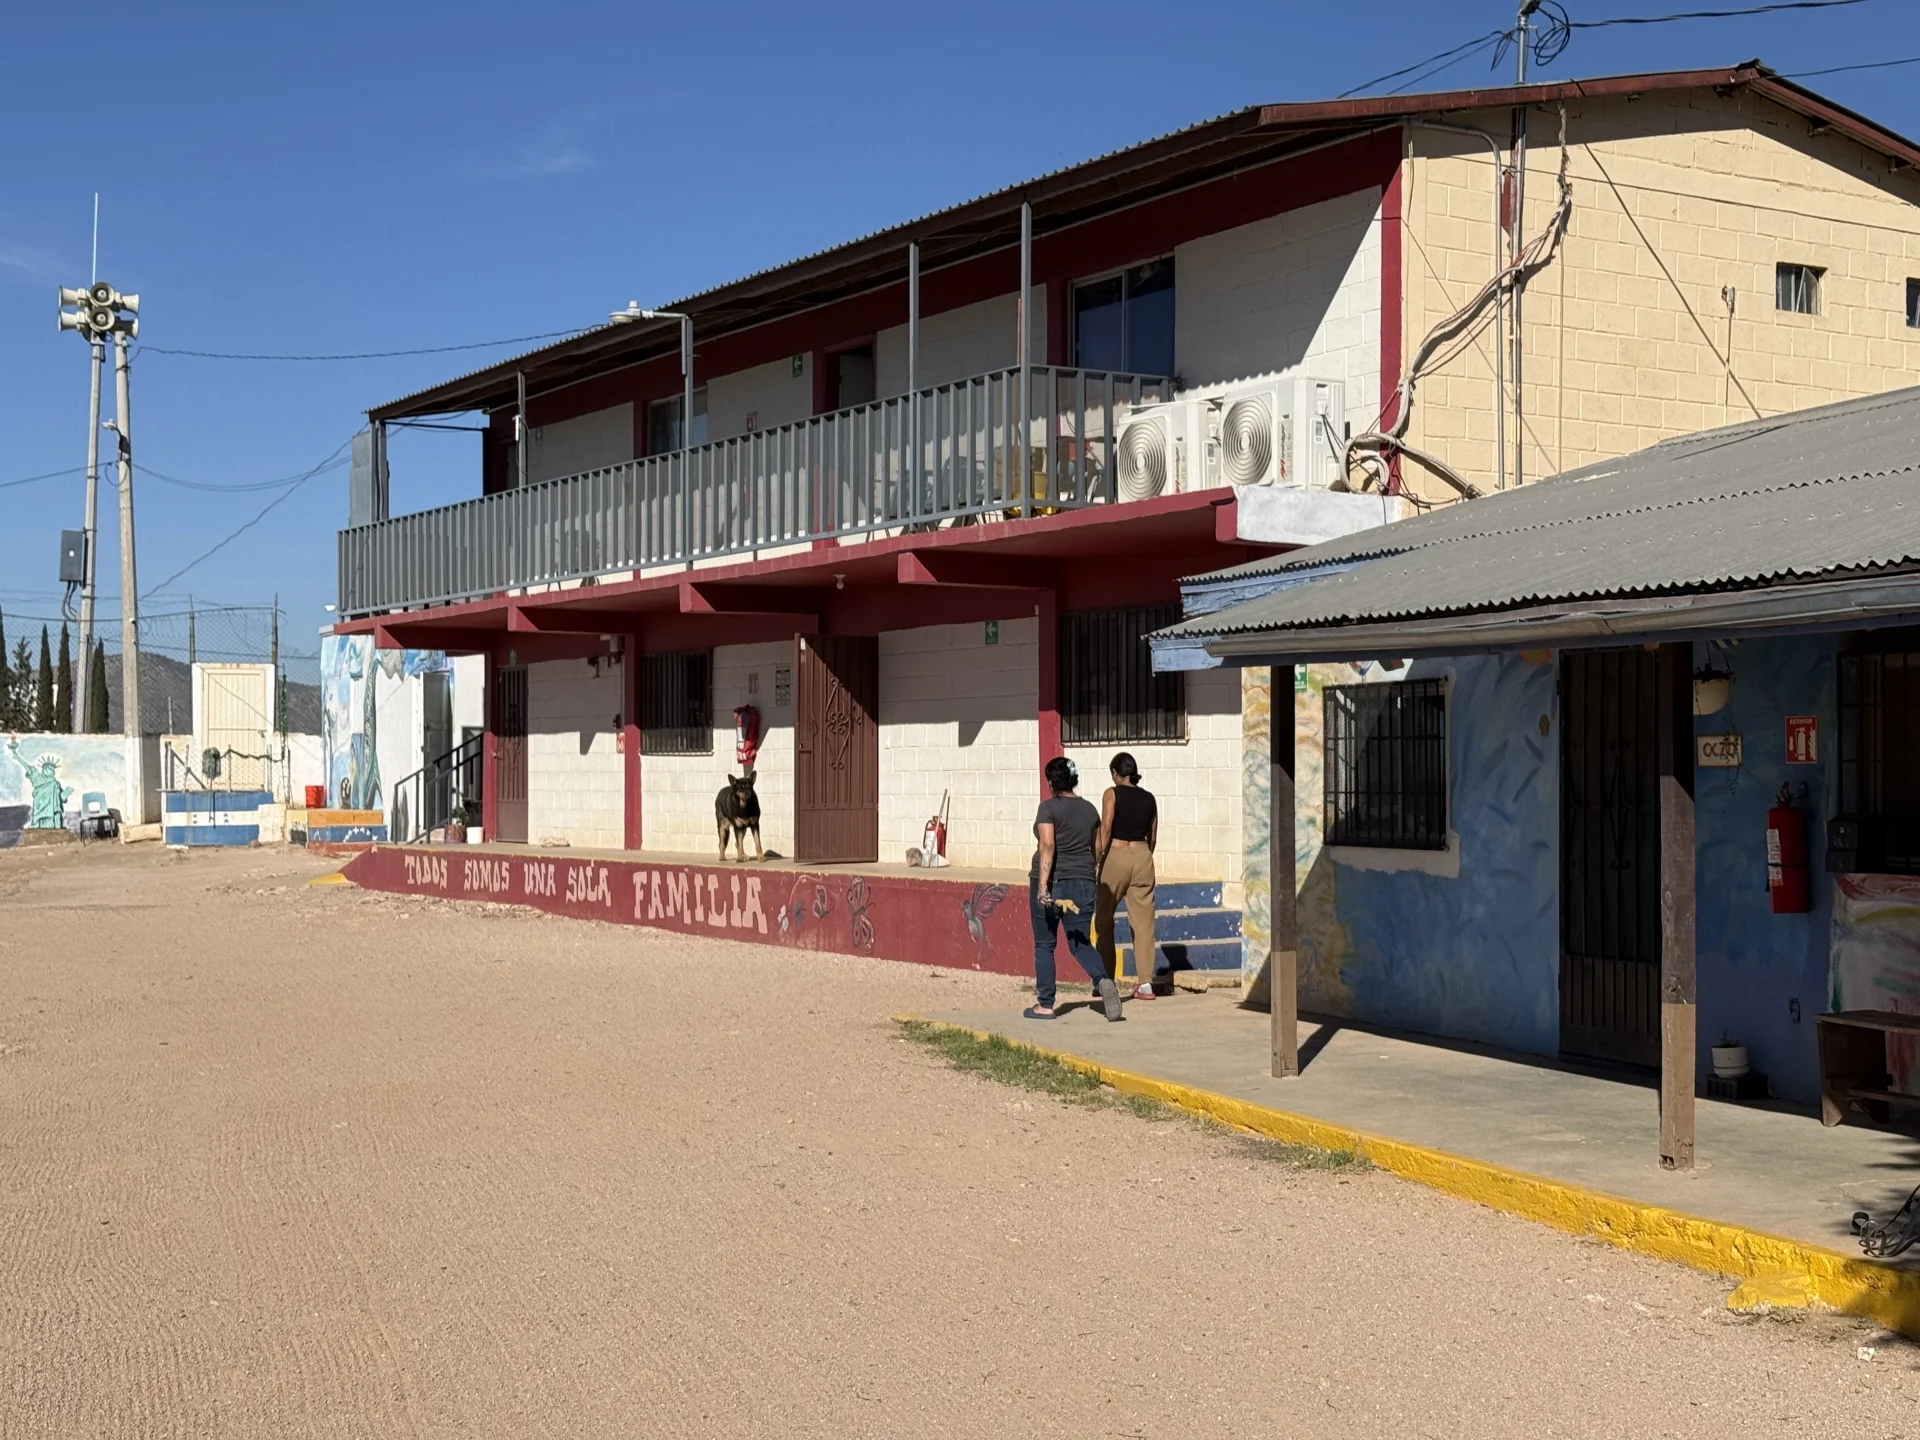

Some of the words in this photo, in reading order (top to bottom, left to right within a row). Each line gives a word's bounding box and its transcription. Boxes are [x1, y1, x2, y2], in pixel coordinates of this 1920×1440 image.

[1789, 718, 1813, 726] EXTINTOR
[404, 854, 448, 890] TODOS
[463, 859, 510, 894] SOMOS
[523, 862, 557, 898] UNA
[565, 865, 612, 907] SOLA
[632, 870, 769, 935] FAMILIA
